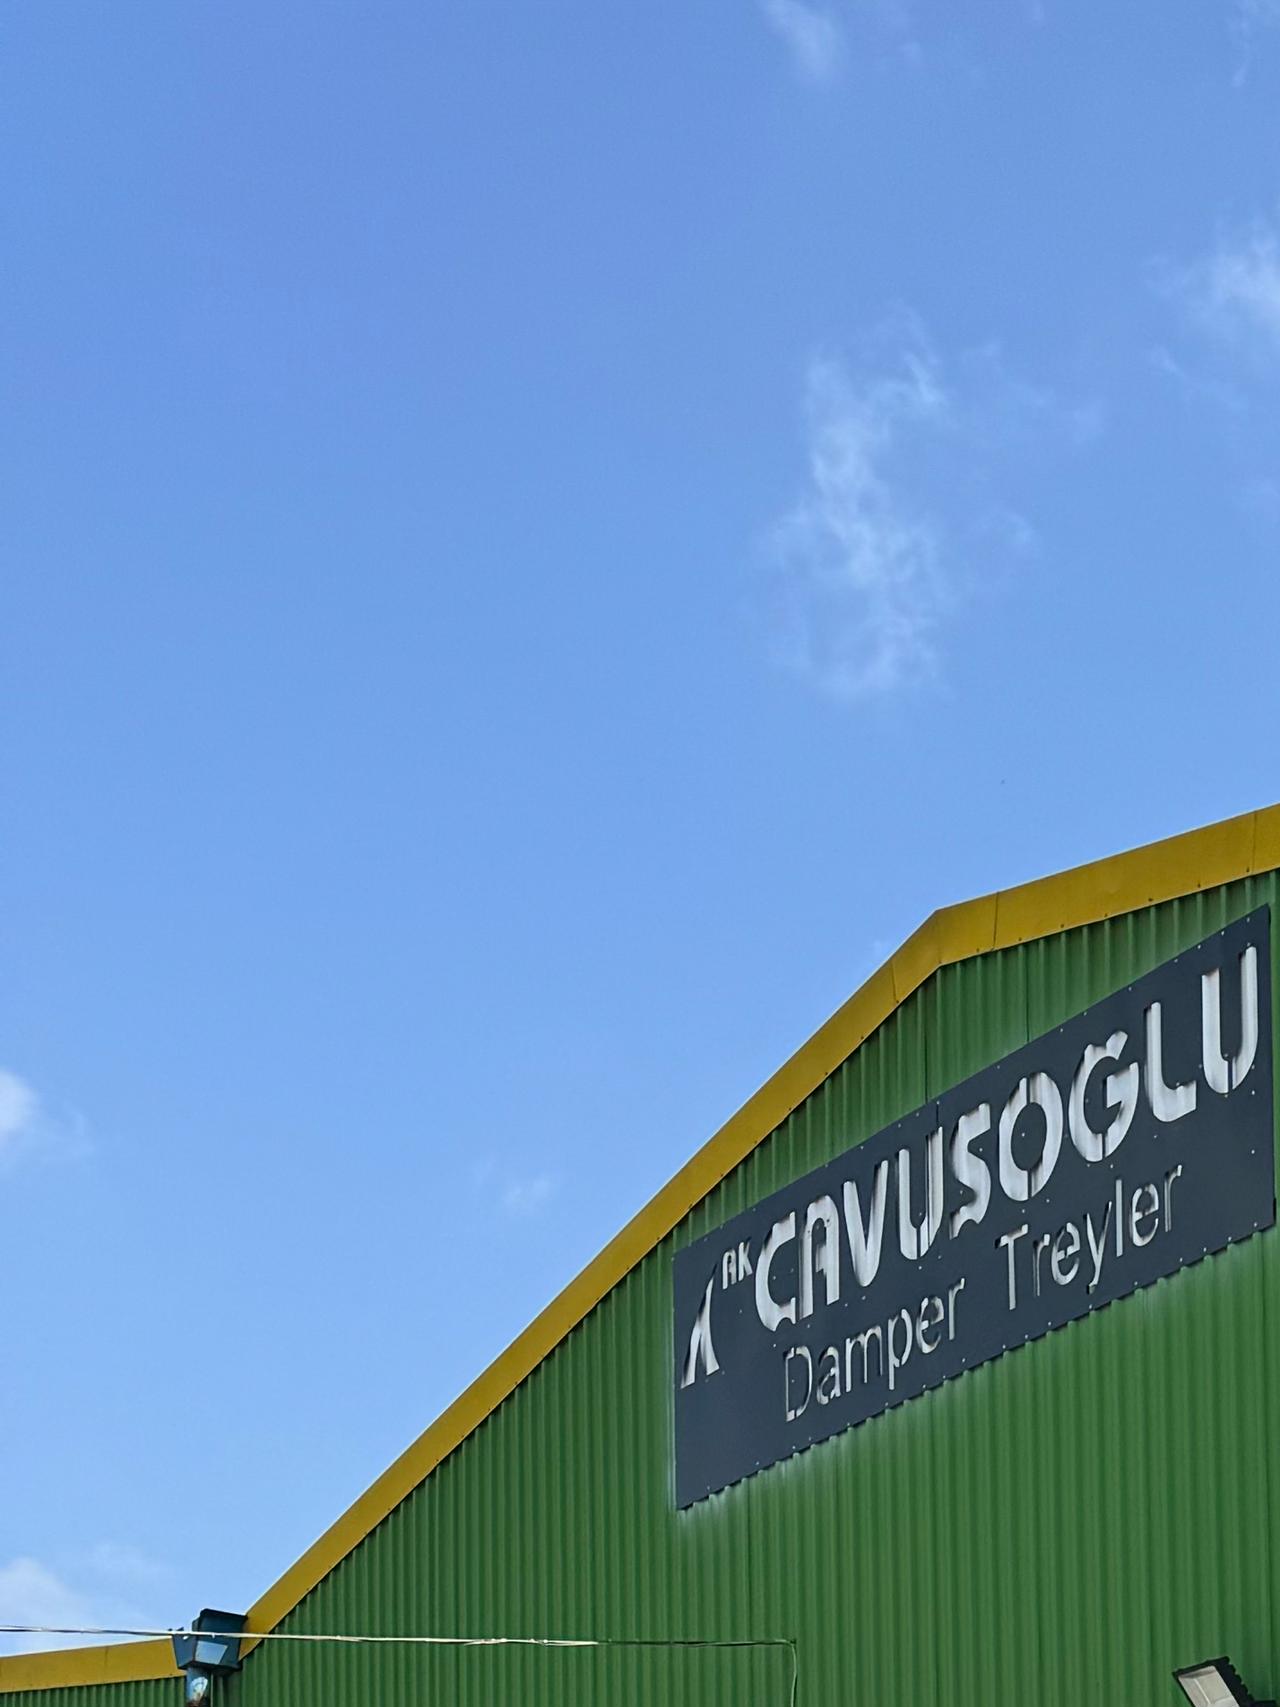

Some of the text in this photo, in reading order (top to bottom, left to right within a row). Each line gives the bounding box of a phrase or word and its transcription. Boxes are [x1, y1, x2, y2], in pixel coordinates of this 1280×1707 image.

[721, 1234, 754, 1290] AK
[784, 1163, 1183, 1423] Damper Treyler
